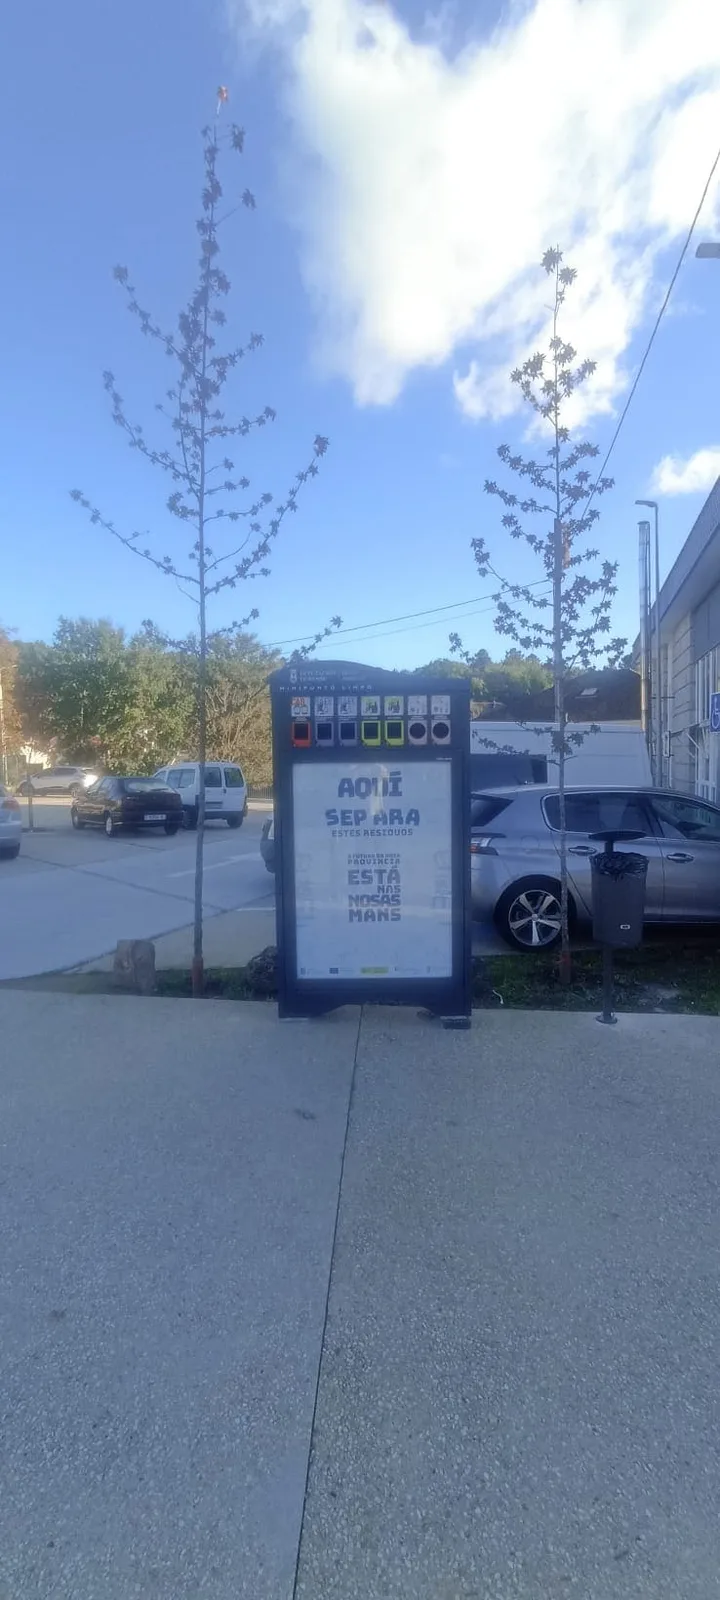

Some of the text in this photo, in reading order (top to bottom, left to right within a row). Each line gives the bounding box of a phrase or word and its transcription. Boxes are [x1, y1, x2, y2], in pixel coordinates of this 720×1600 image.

[279, 684, 335, 692] MINIPUNTO
[338, 771, 402, 799] AQUÍ
[332, 828, 413, 838] ESTES RESIDUOS
[347, 865, 401, 885] ESTÁ
[376, 885, 401, 894] NAS
[348, 894, 401, 907] NOSAS
[348, 908, 401, 923] MANS
